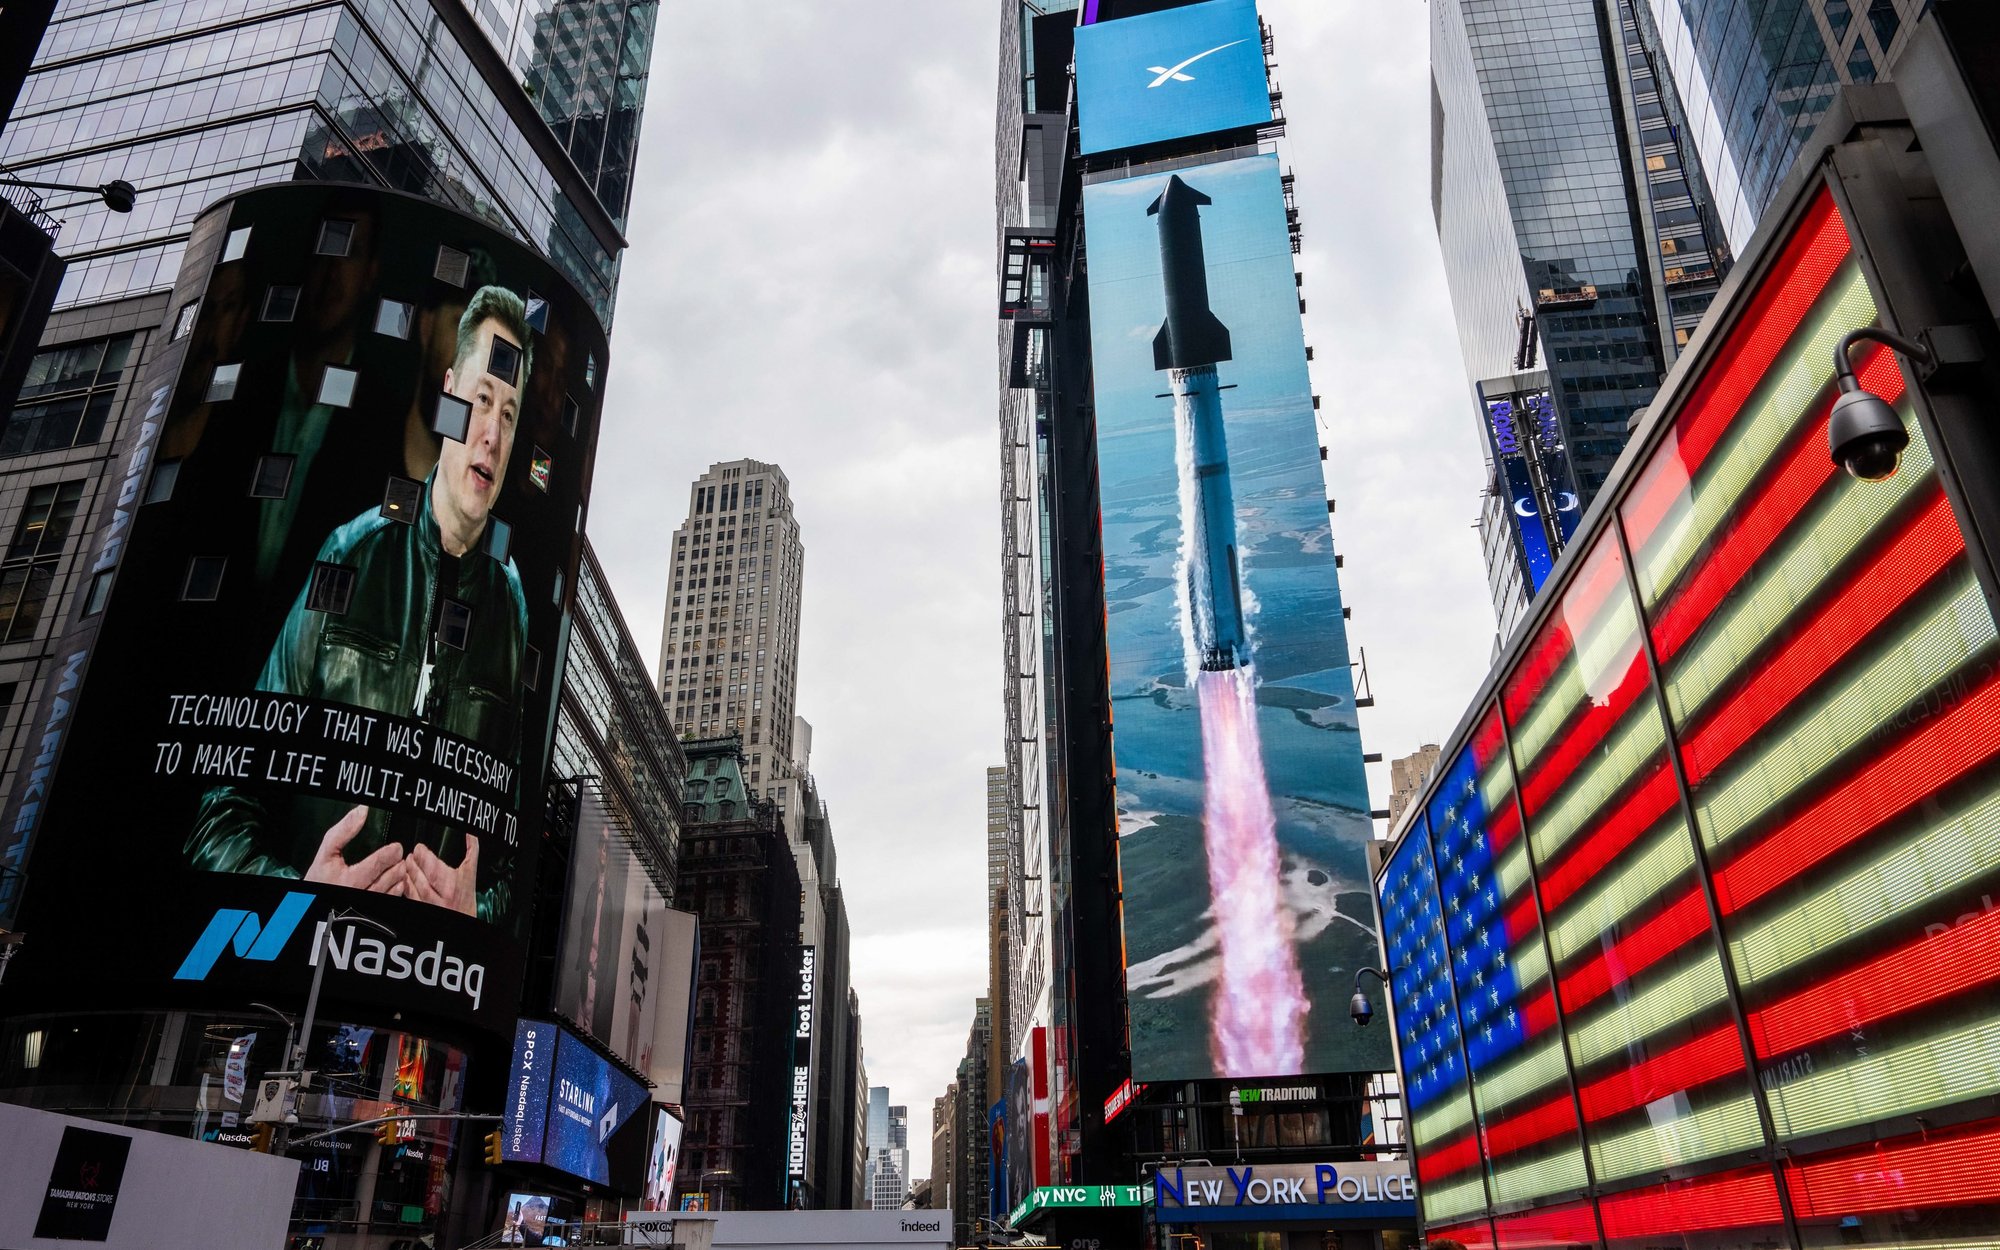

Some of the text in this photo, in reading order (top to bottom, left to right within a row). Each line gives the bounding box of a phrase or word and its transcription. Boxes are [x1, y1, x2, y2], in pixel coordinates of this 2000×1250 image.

[1489, 402, 1516, 453] ROKU
[168, 694, 513, 794] TECHNOLOGY THAT WAS NECESSARY
[155, 742, 519, 848] TO MAKE LIFE MULTI-PLANETARY TO.
[308, 921, 485, 1010] Nasdaq
[797, 1004, 811, 1037] Foot
[522, 1030, 536, 1070] SPCX
[559, 1078, 595, 1115] STARLINK
[793, 1066, 808, 1105] HERE
[789, 1122, 806, 1175] HOOPS
[97, 1193, 113, 1203] STORE
[1053, 1188, 1087, 1203] NYC
[1155, 1164, 1415, 1207] NEW YORK POLICE
[640, 1222, 659, 1233] FOX
[901, 1220, 940, 1232] indeed
